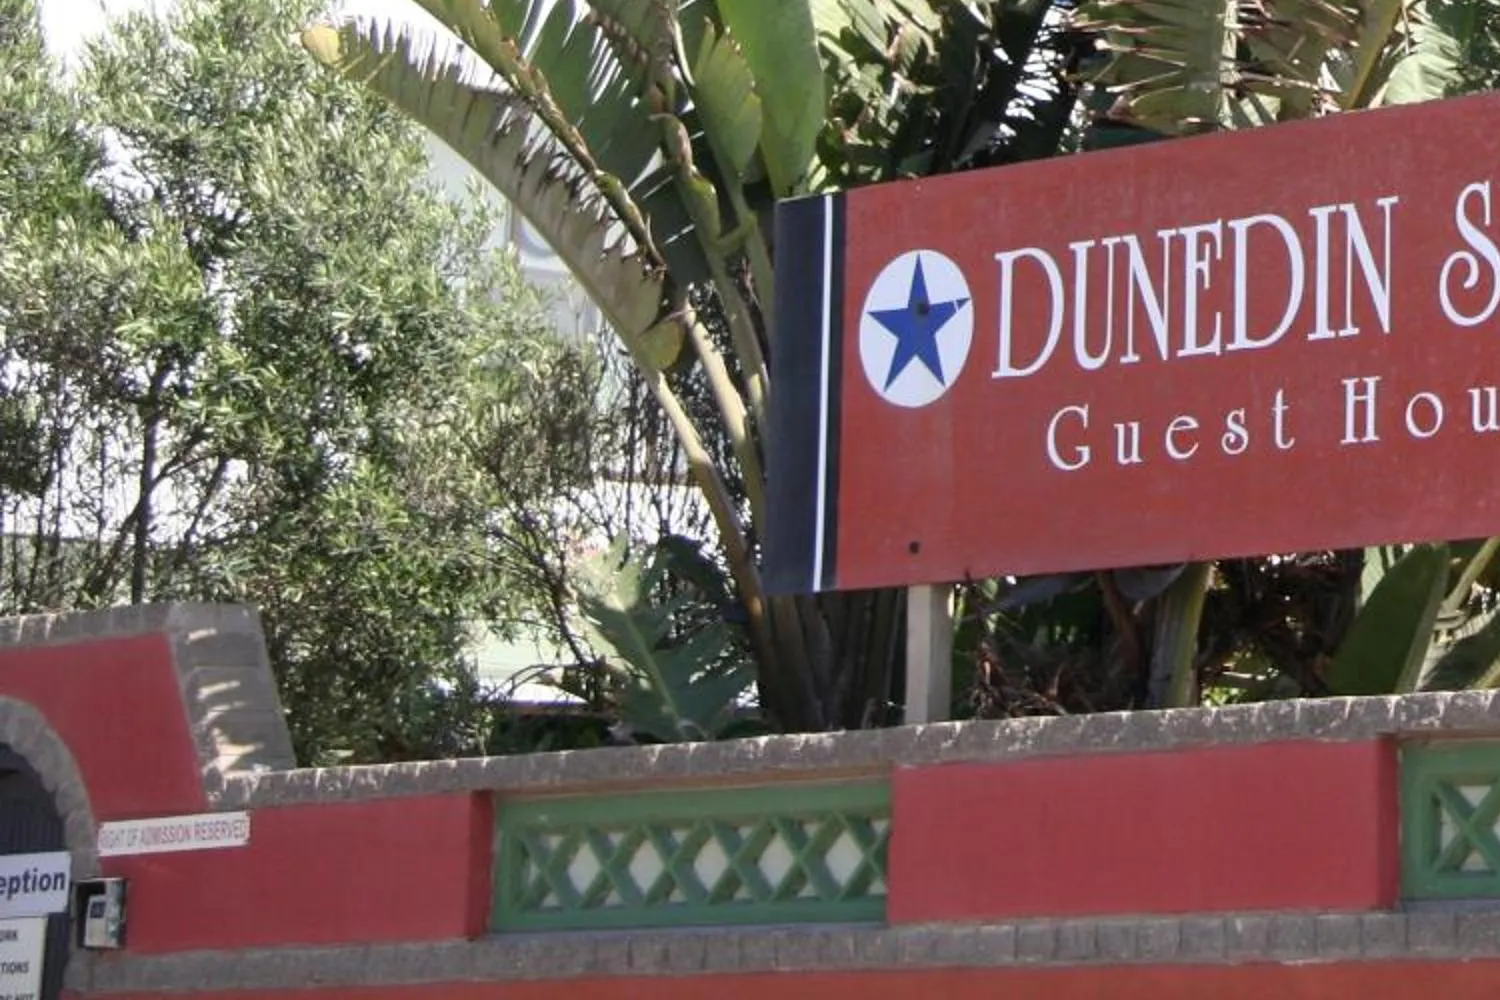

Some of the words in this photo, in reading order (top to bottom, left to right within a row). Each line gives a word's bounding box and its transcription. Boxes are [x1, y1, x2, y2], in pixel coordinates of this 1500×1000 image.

[992, 196, 1398, 379] DUNEDIN
[1047, 389, 1295, 471] Guest
[194, 818, 247, 842] RESERVED
